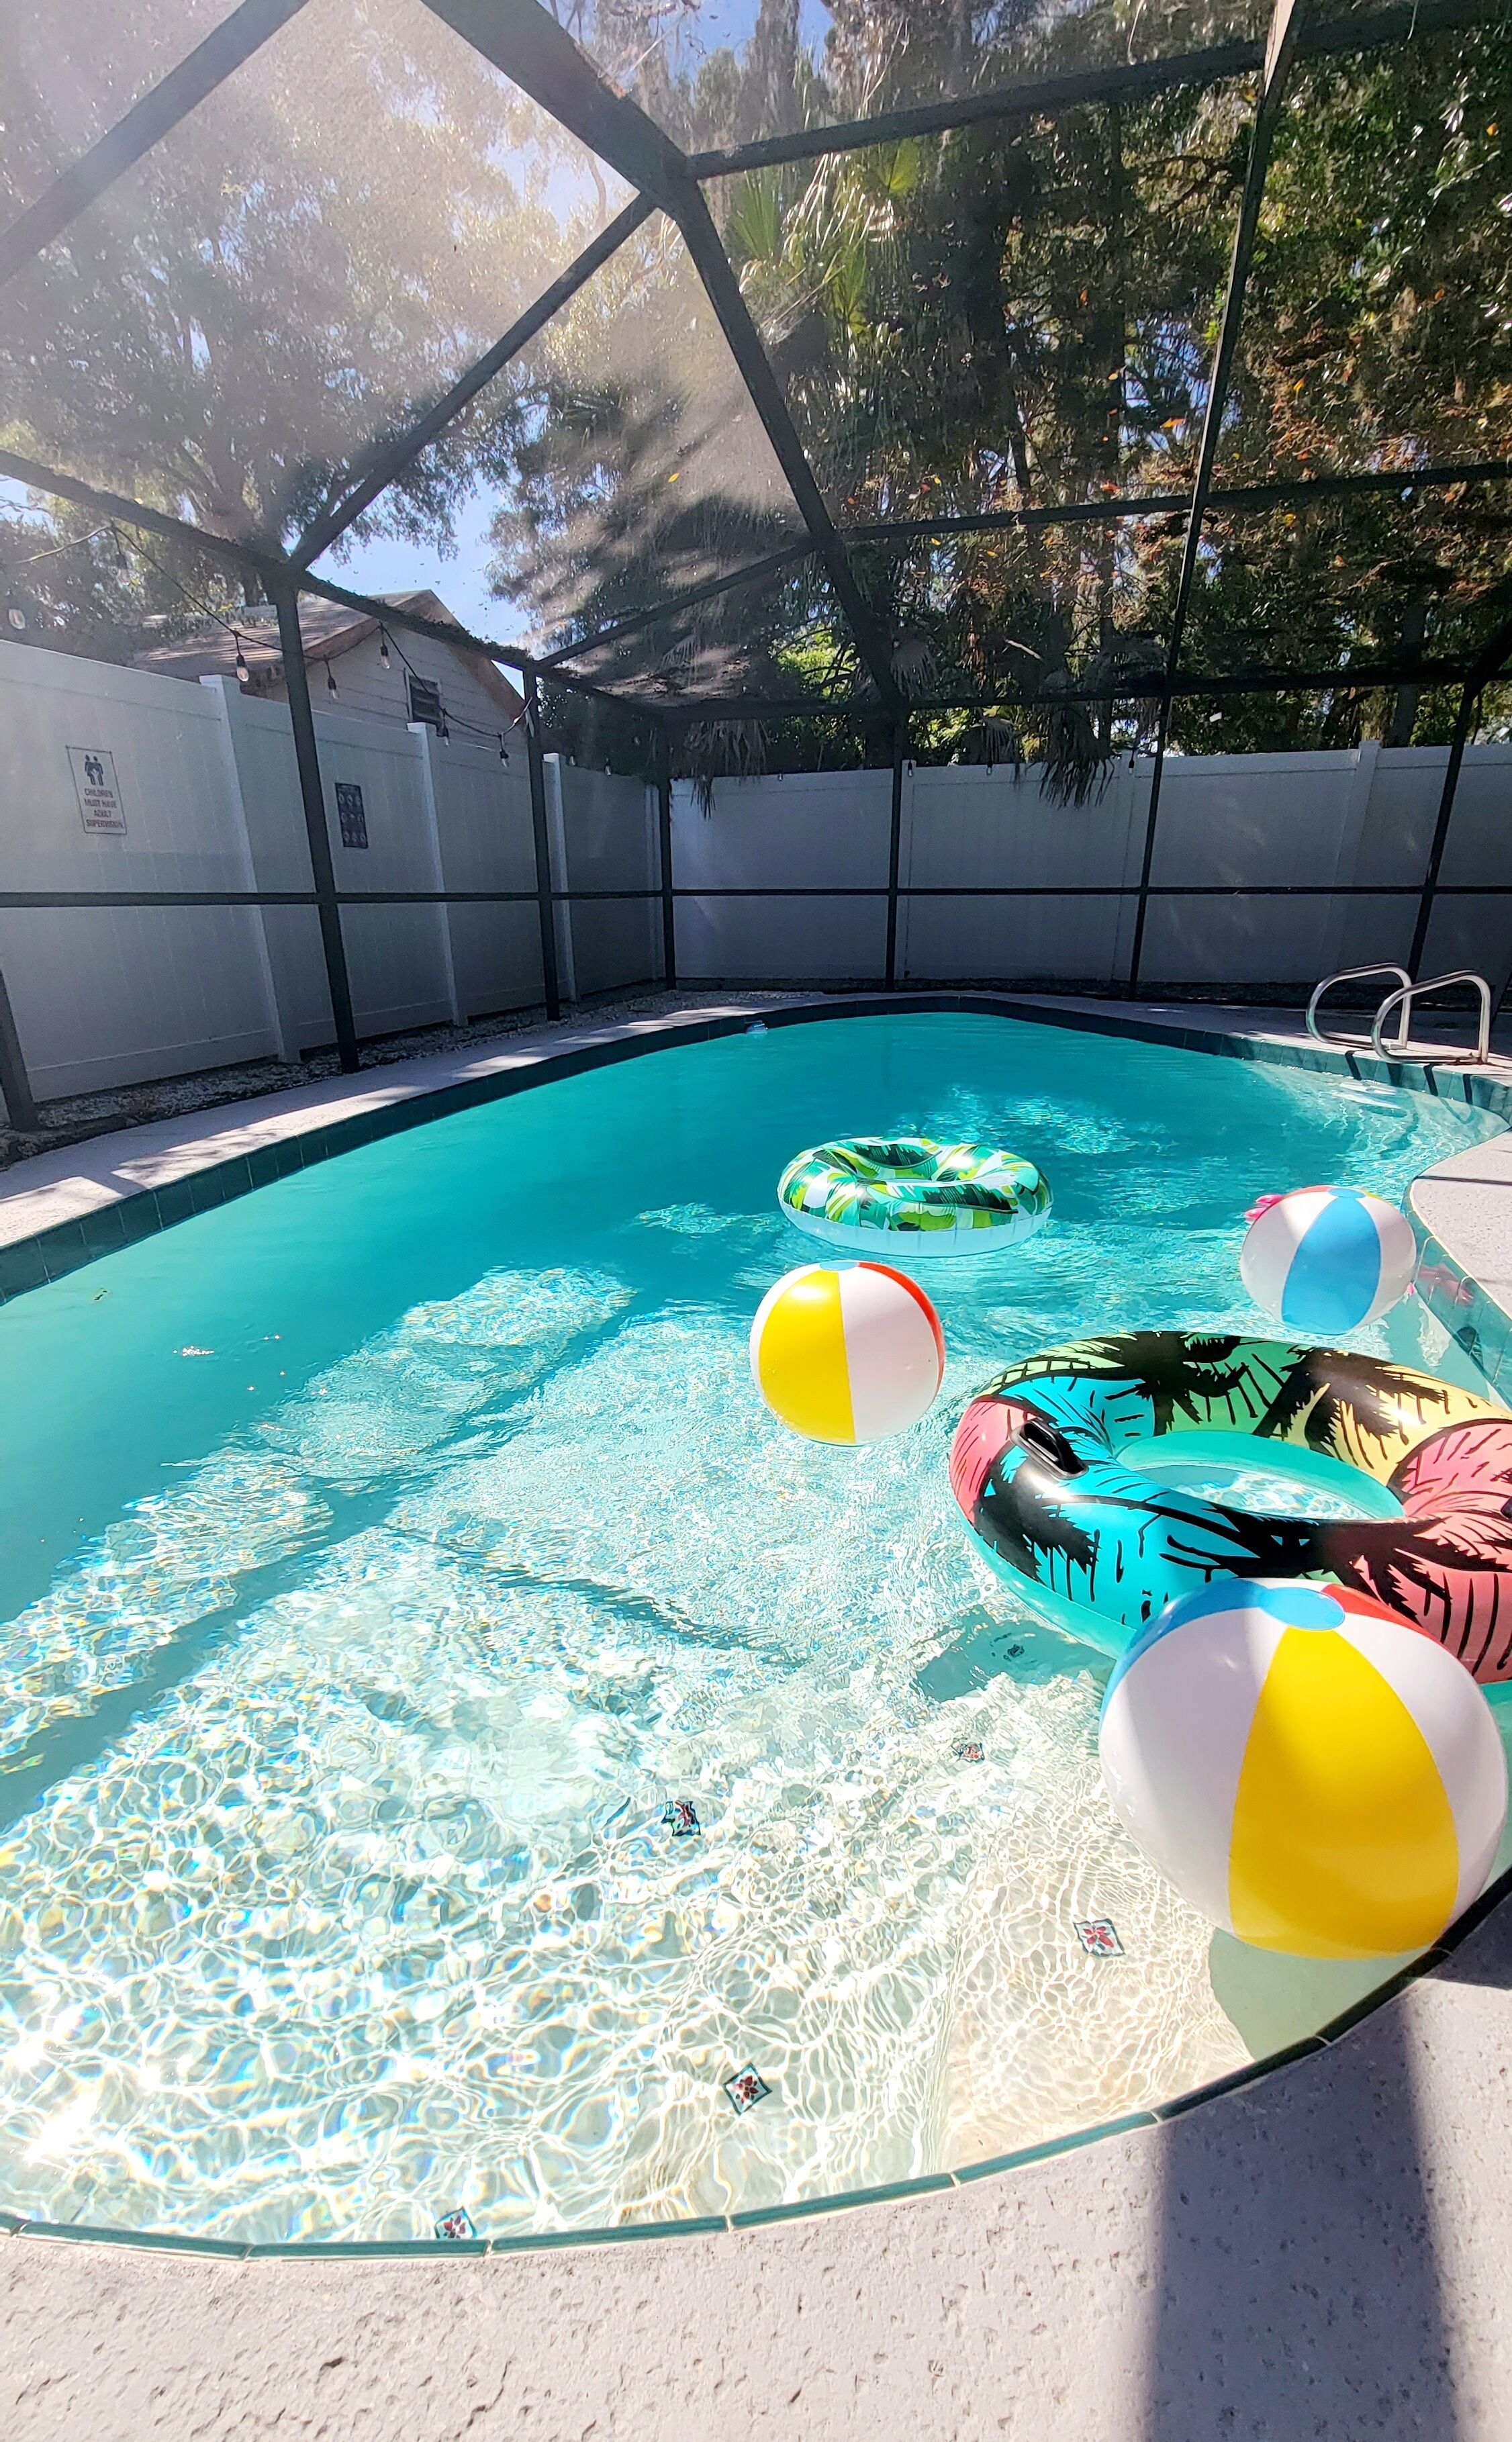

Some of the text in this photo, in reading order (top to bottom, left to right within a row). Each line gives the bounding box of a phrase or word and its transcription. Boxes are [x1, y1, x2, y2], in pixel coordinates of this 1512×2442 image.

[84, 788, 113, 798] CHILDREN
[84, 798, 117, 808] MUST HAVE
[94, 810, 111, 818] ADULT
[86, 819, 124, 829] SUPERVISION
